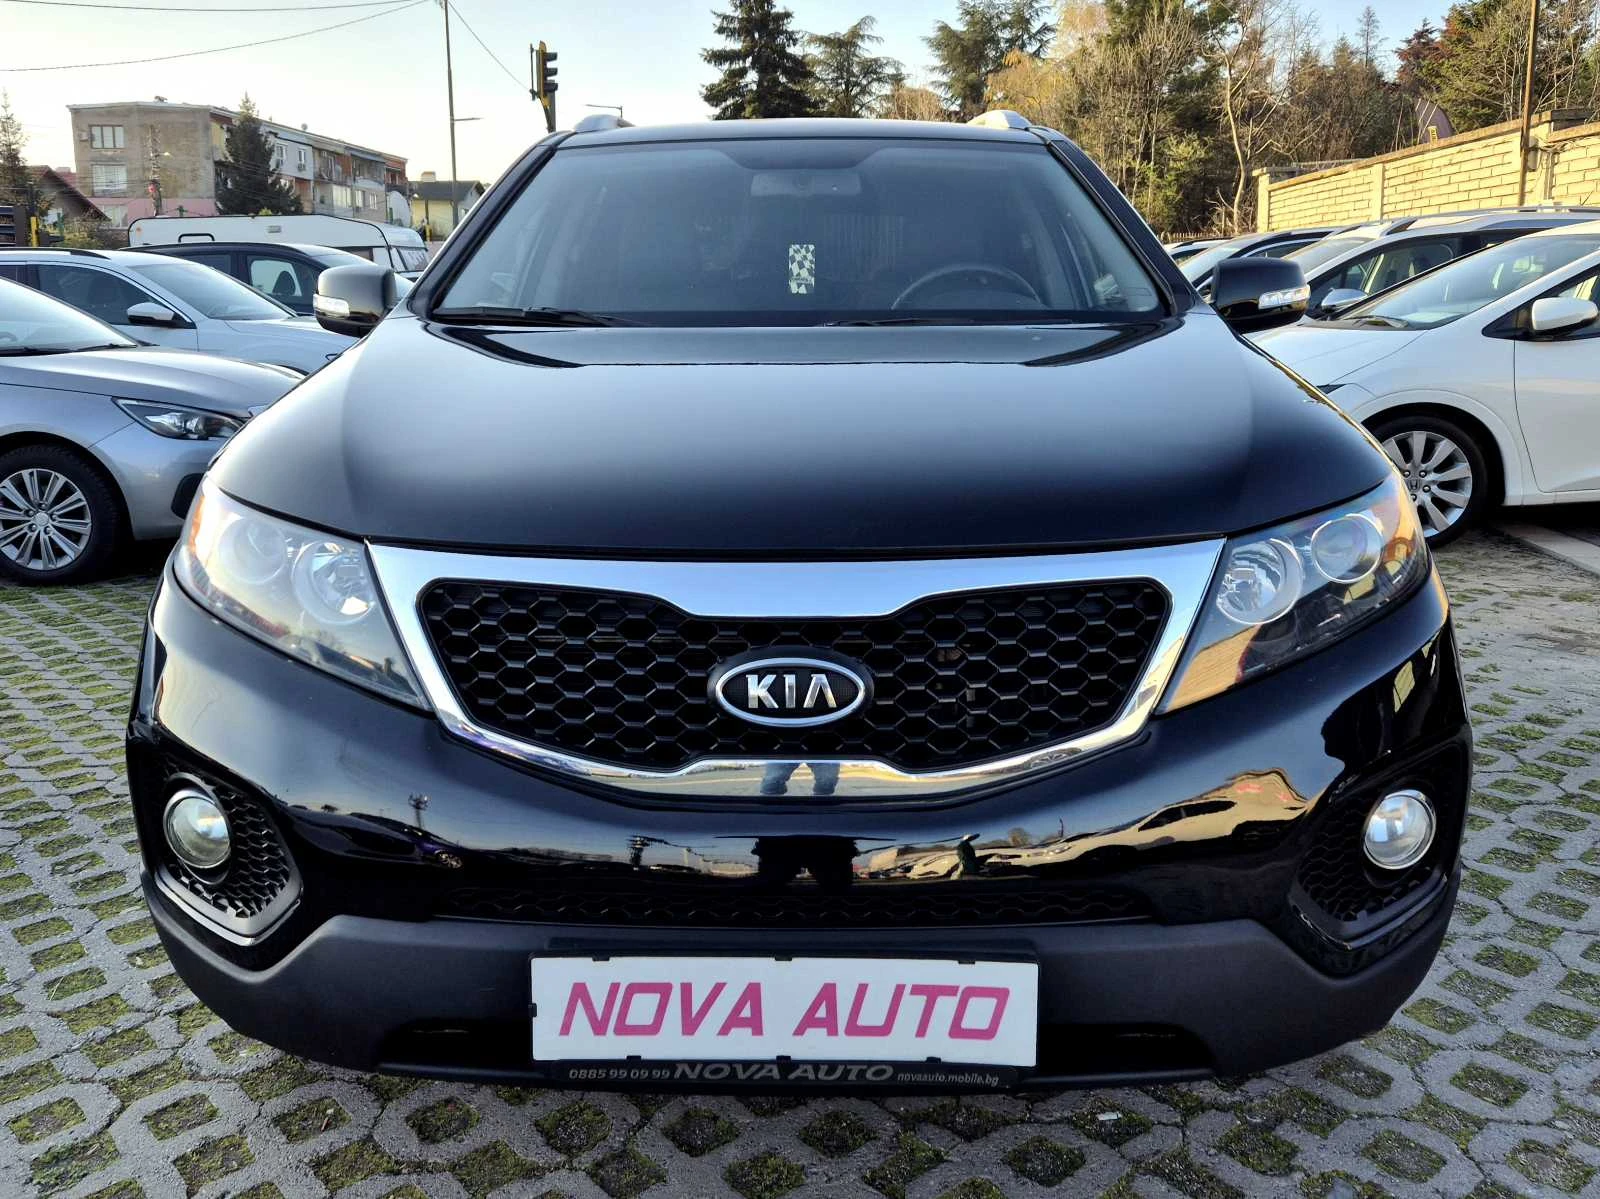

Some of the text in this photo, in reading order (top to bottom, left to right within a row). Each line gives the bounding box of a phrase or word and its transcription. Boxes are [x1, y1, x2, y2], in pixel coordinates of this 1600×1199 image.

[745, 673, 838, 709] KIA
[558, 981, 1011, 1041] NOVA AUTO
[568, 1063, 1000, 1087] 0885 99 09 99 NOVA AUTO novaauto.mobile.bg
